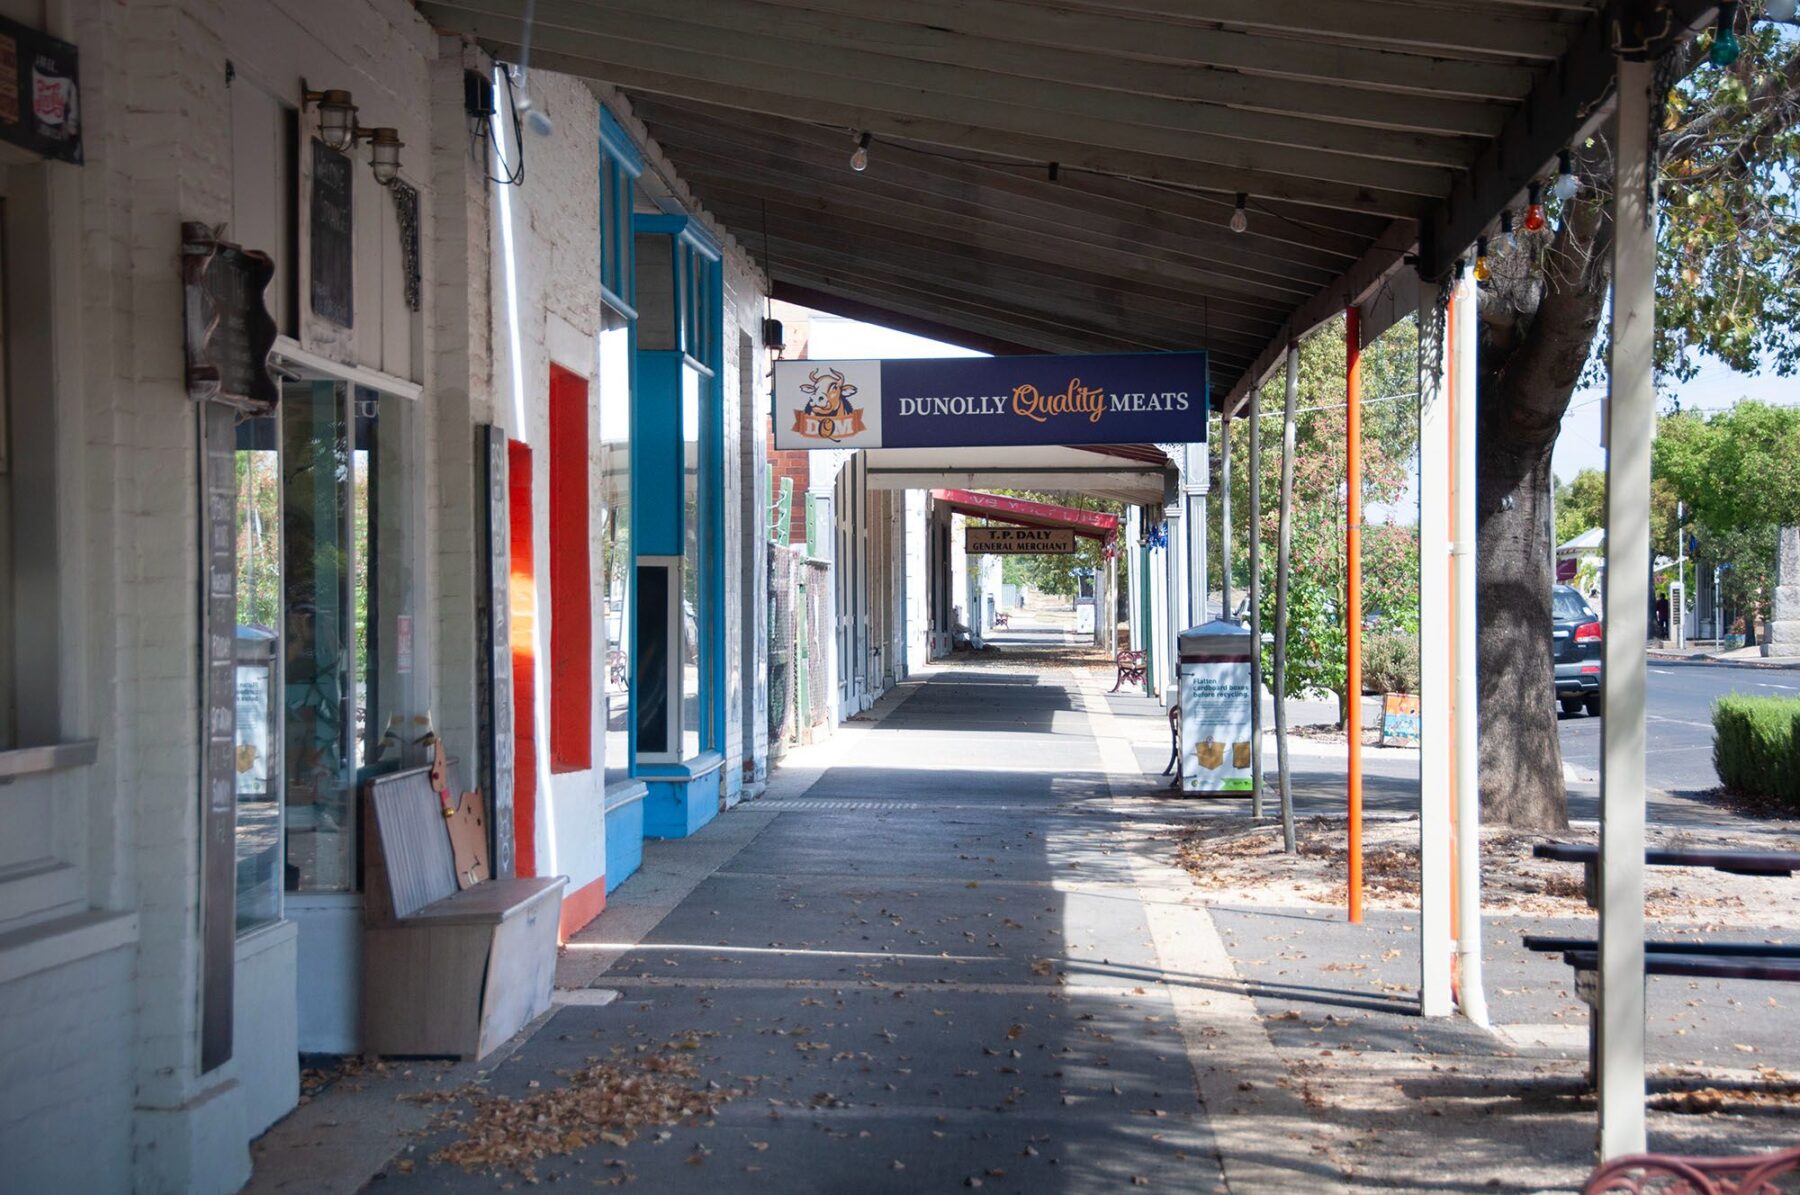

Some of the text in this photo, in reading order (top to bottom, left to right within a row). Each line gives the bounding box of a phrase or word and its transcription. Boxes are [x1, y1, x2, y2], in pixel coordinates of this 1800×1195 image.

[899, 377, 1190, 423] DUNOLLY Quality MEATS
[807, 418, 854, 443] DQM
[1016, 531, 1052, 540] DALY
[973, 542, 1067, 551] GENERAL MERCHANT
